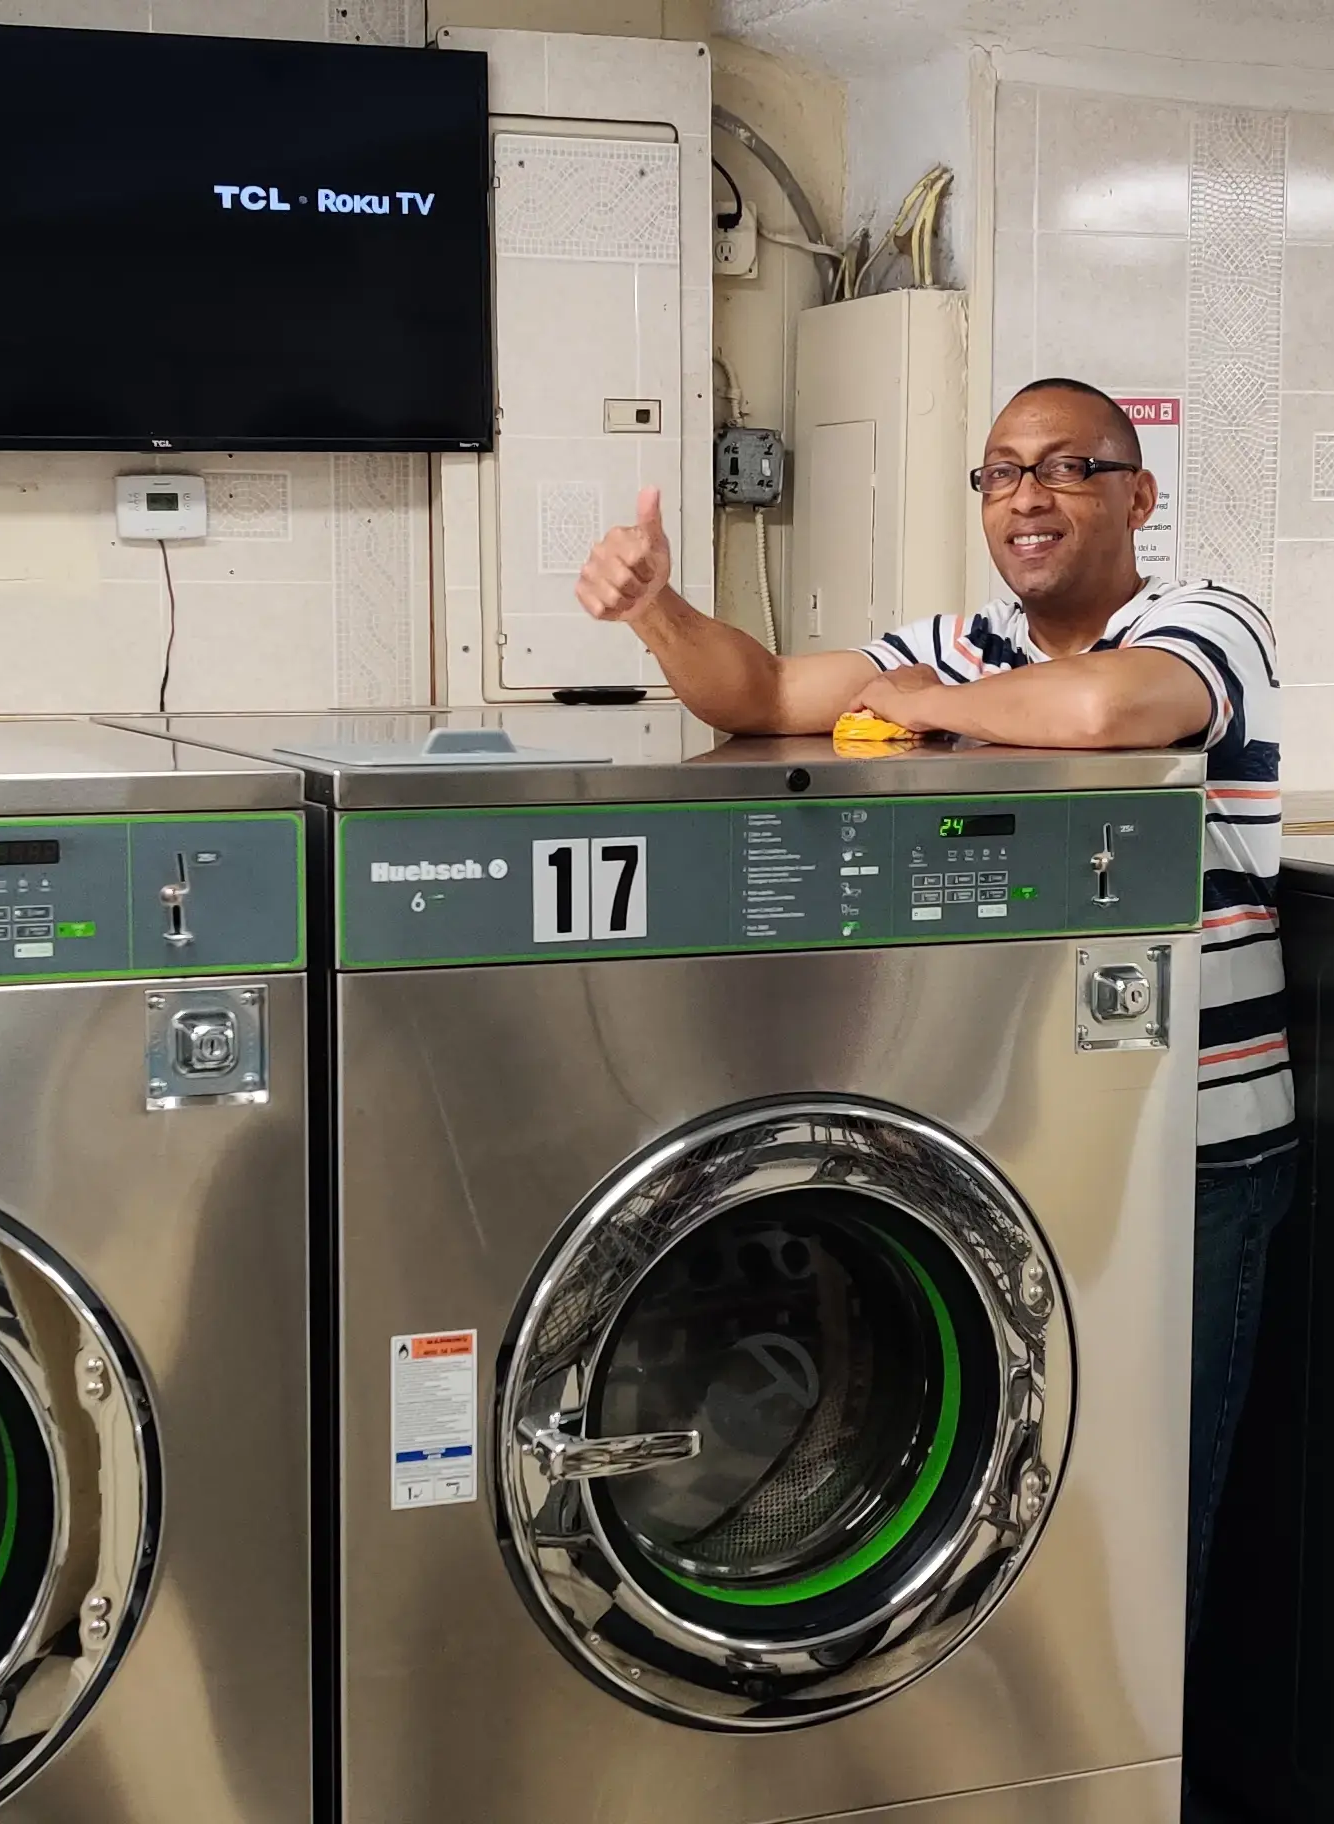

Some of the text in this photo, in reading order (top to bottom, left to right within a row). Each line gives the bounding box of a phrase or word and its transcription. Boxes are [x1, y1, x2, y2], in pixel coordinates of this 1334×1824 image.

[214, 185, 435, 215] TCL Roku TV
[939, 818, 964, 837] 24
[371, 859, 484, 882] Huebsch
[548, 845, 639, 933] 17
[411, 891, 426, 912] 6
